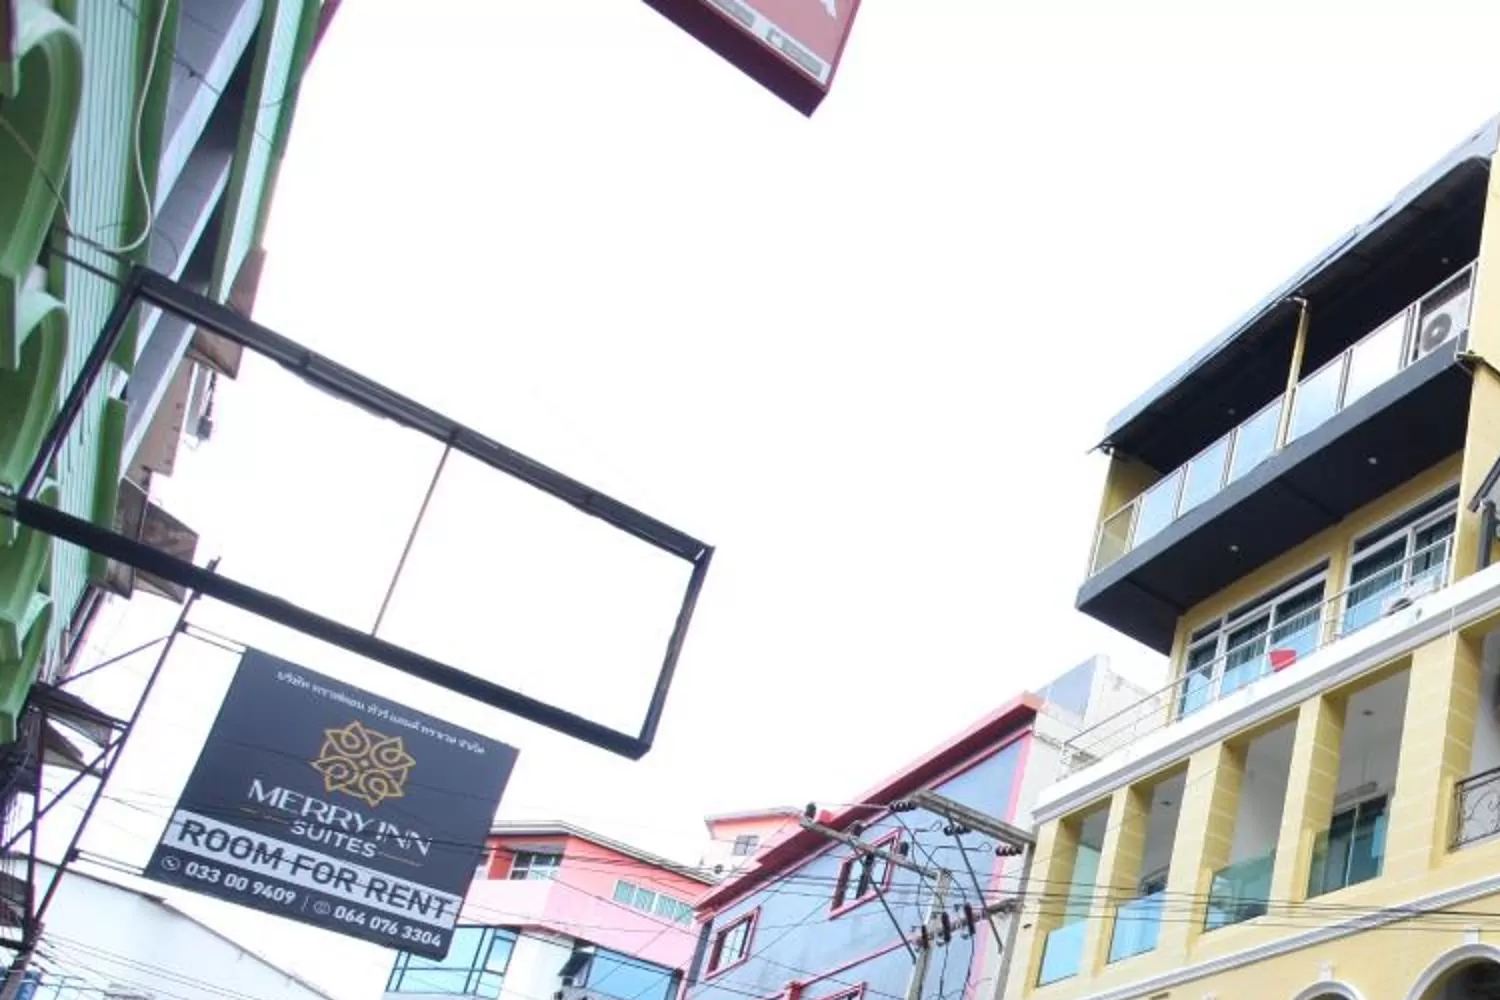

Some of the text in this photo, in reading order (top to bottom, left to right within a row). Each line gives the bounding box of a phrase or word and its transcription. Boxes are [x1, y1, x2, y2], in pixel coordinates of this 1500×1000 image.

[248, 778, 432, 856] MERRY INN
[291, 820, 378, 859] SUITES
[178, 819, 454, 921] ROOM FOR RENT
[185, 861, 443, 949] 033 00 9409 064 076 3304
